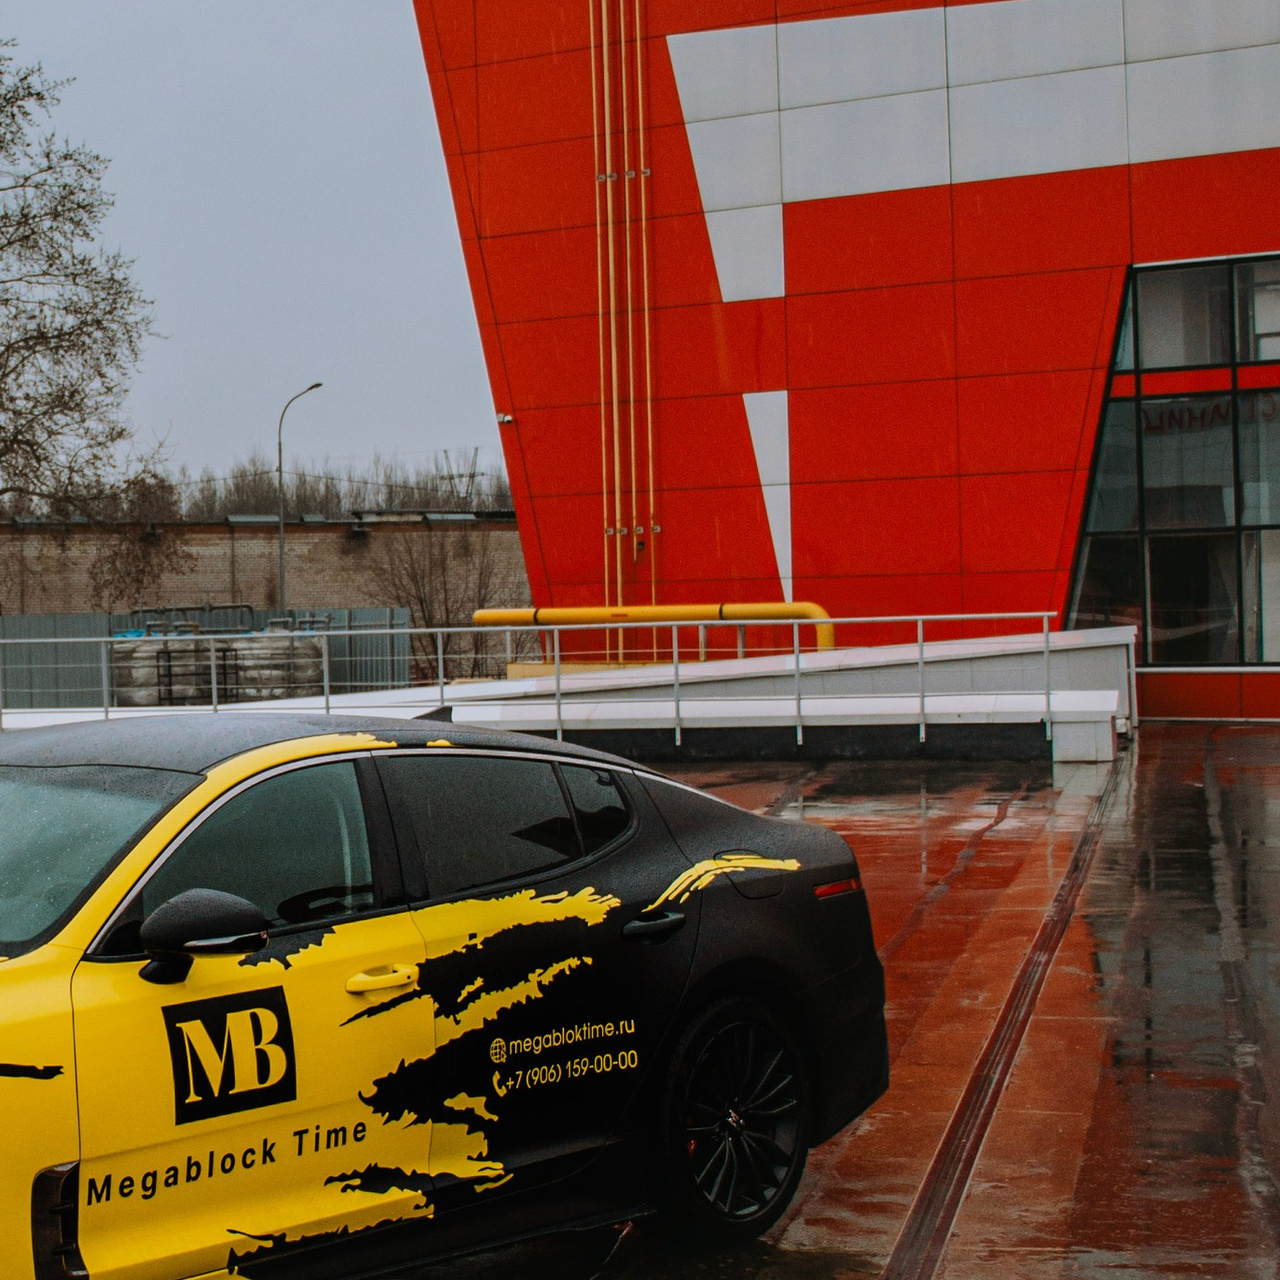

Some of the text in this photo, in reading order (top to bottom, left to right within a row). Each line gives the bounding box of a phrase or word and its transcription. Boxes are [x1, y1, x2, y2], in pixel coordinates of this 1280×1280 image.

[175, 1007, 287, 1104] MB
[509, 1019, 635, 1055] megabloktime.ru
[506, 1049, 639, 1090] +7 (906) 159-00-00
[86, 1121, 367, 1206] Megablock Time
